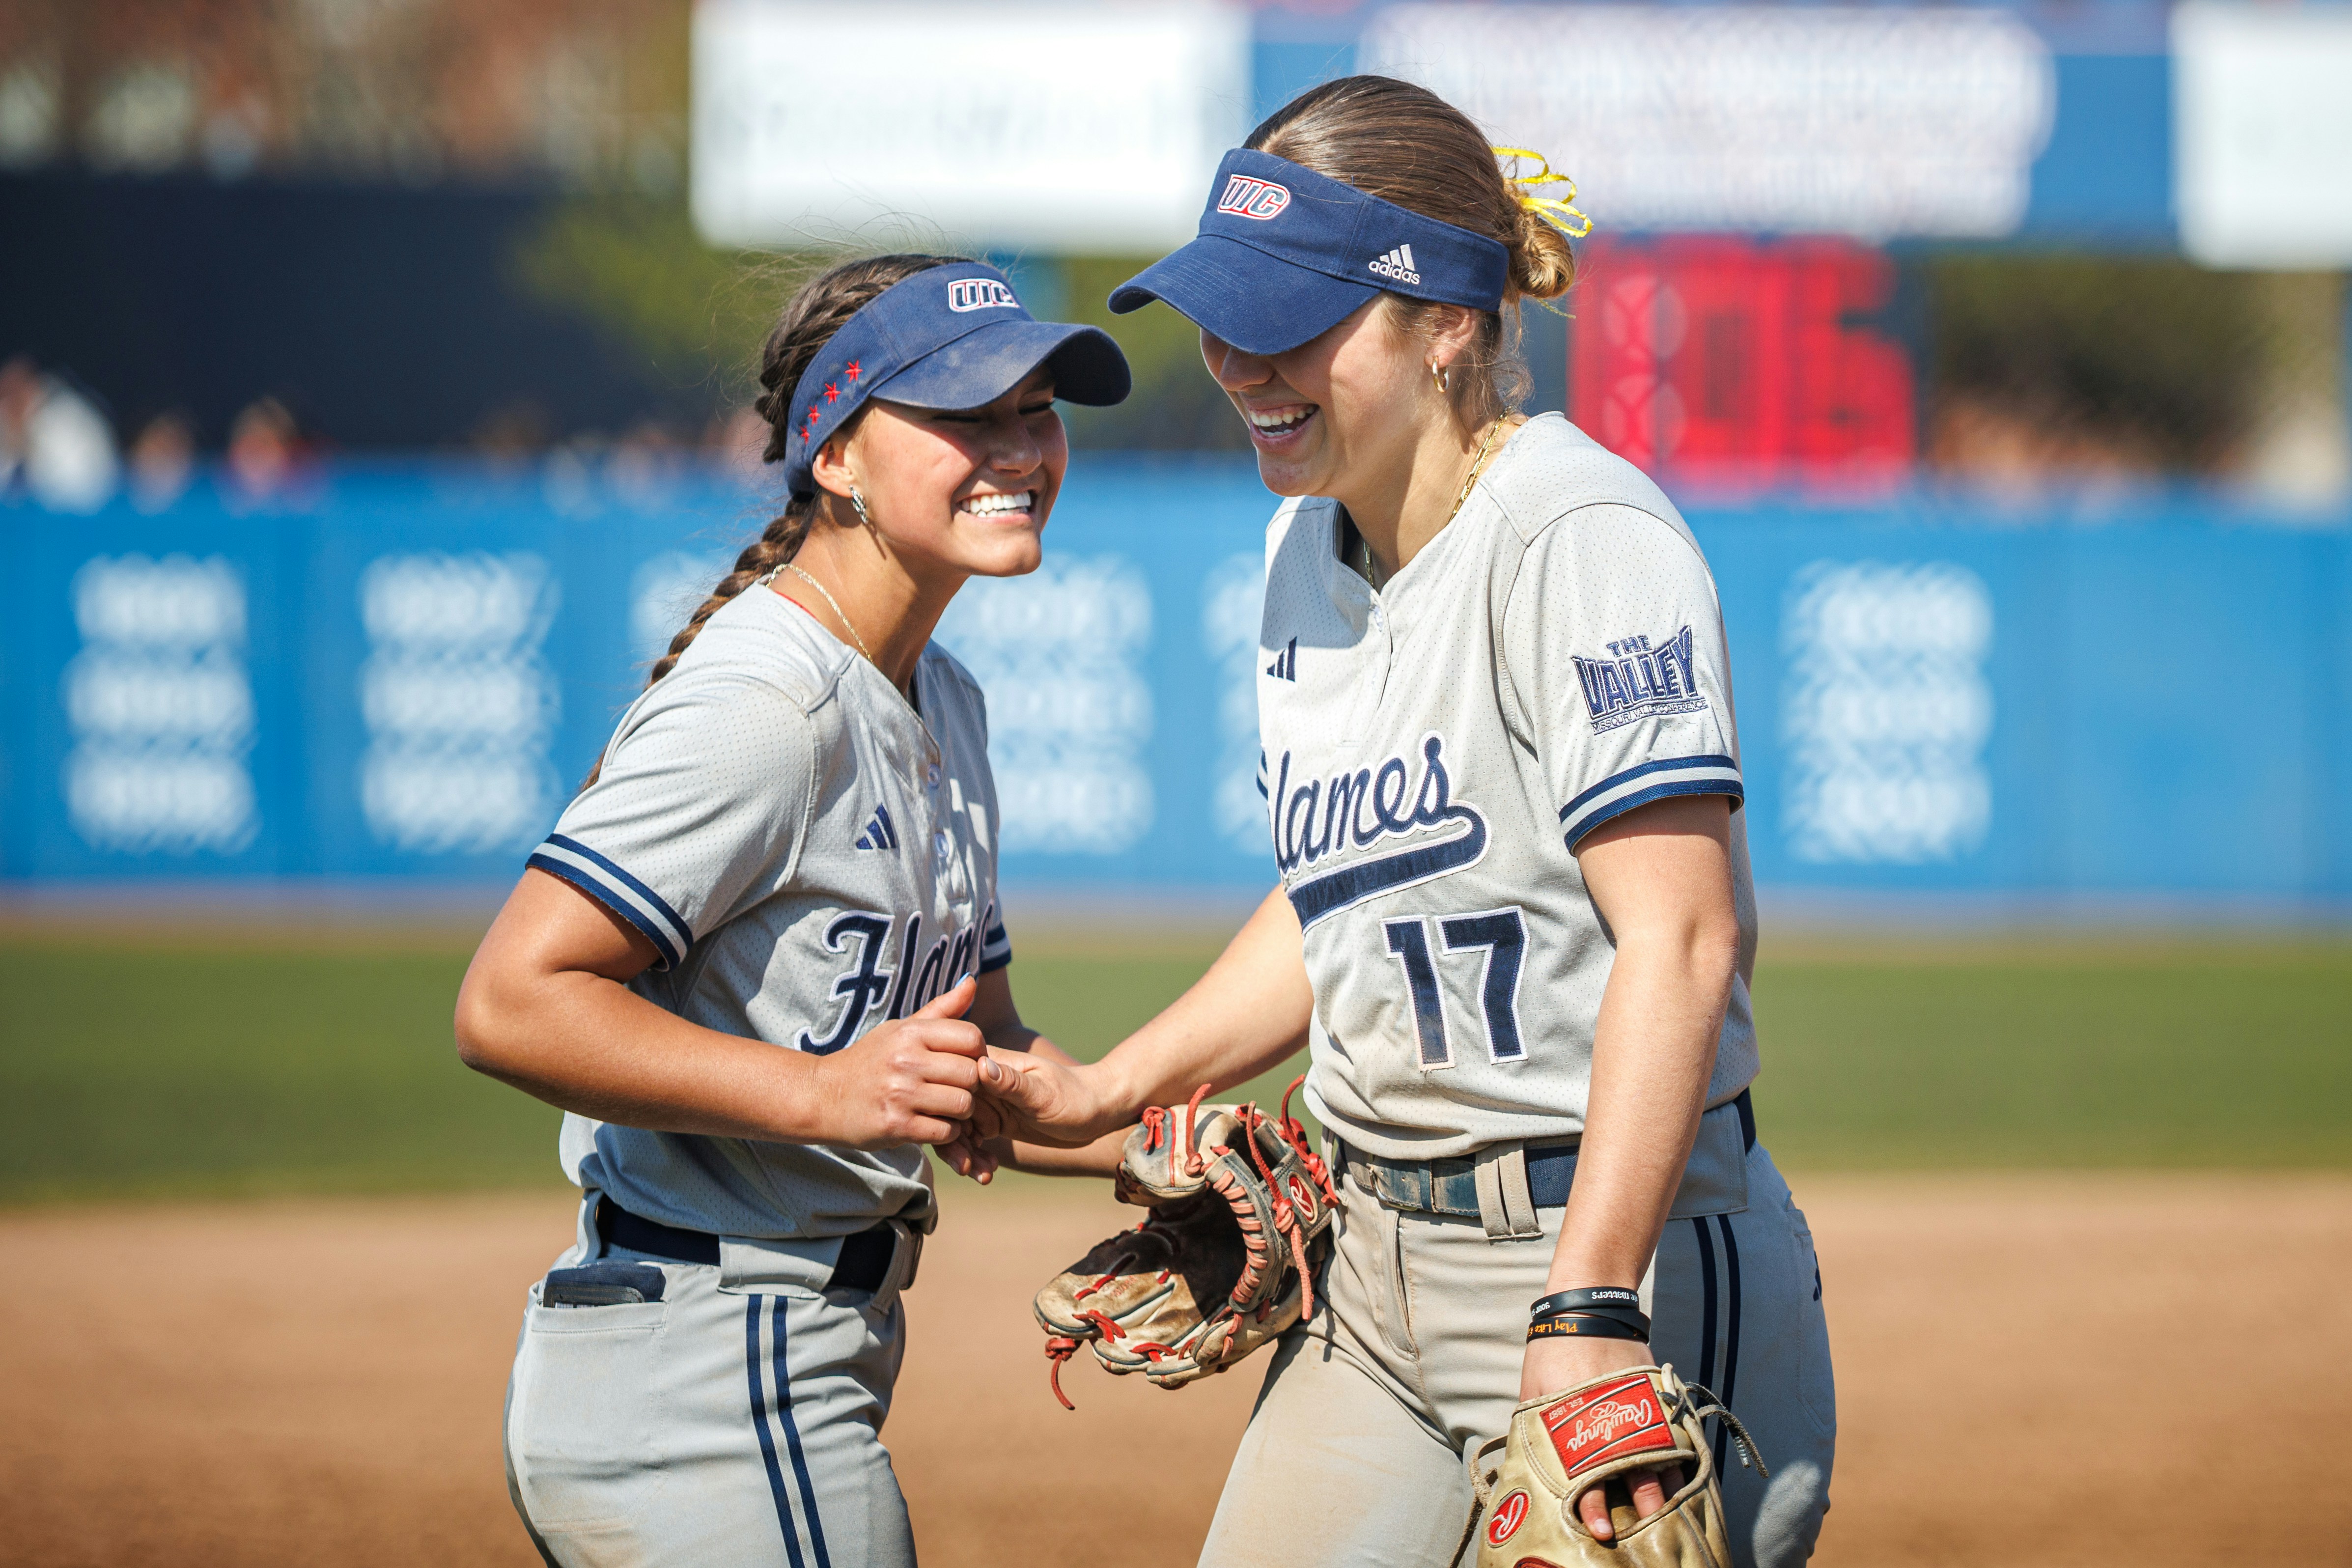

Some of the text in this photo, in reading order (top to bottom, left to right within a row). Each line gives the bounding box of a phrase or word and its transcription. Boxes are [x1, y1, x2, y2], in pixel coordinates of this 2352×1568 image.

[1218, 174, 1290, 220] UIC
[1368, 260, 1421, 285] adidas
[948, 279, 1019, 312] UIC
[1606, 635, 1652, 658] THE
[1571, 625, 1699, 720] VALLEY
[1591, 710, 1631, 733] MISSOURI
[1658, 700, 1708, 713] CONFERENCE
[1273, 730, 1454, 879] lames
[1379, 904, 1530, 1072] 17
[1536, 1302, 1550, 1314] your
[1592, 1290, 1629, 1299] matters
[1535, 1323, 1552, 1333] Like
[1554, 1319, 1578, 1333] Play
[1549, 1405, 1568, 1421] 1887
[1566, 1398, 1652, 1451] Rawlings
